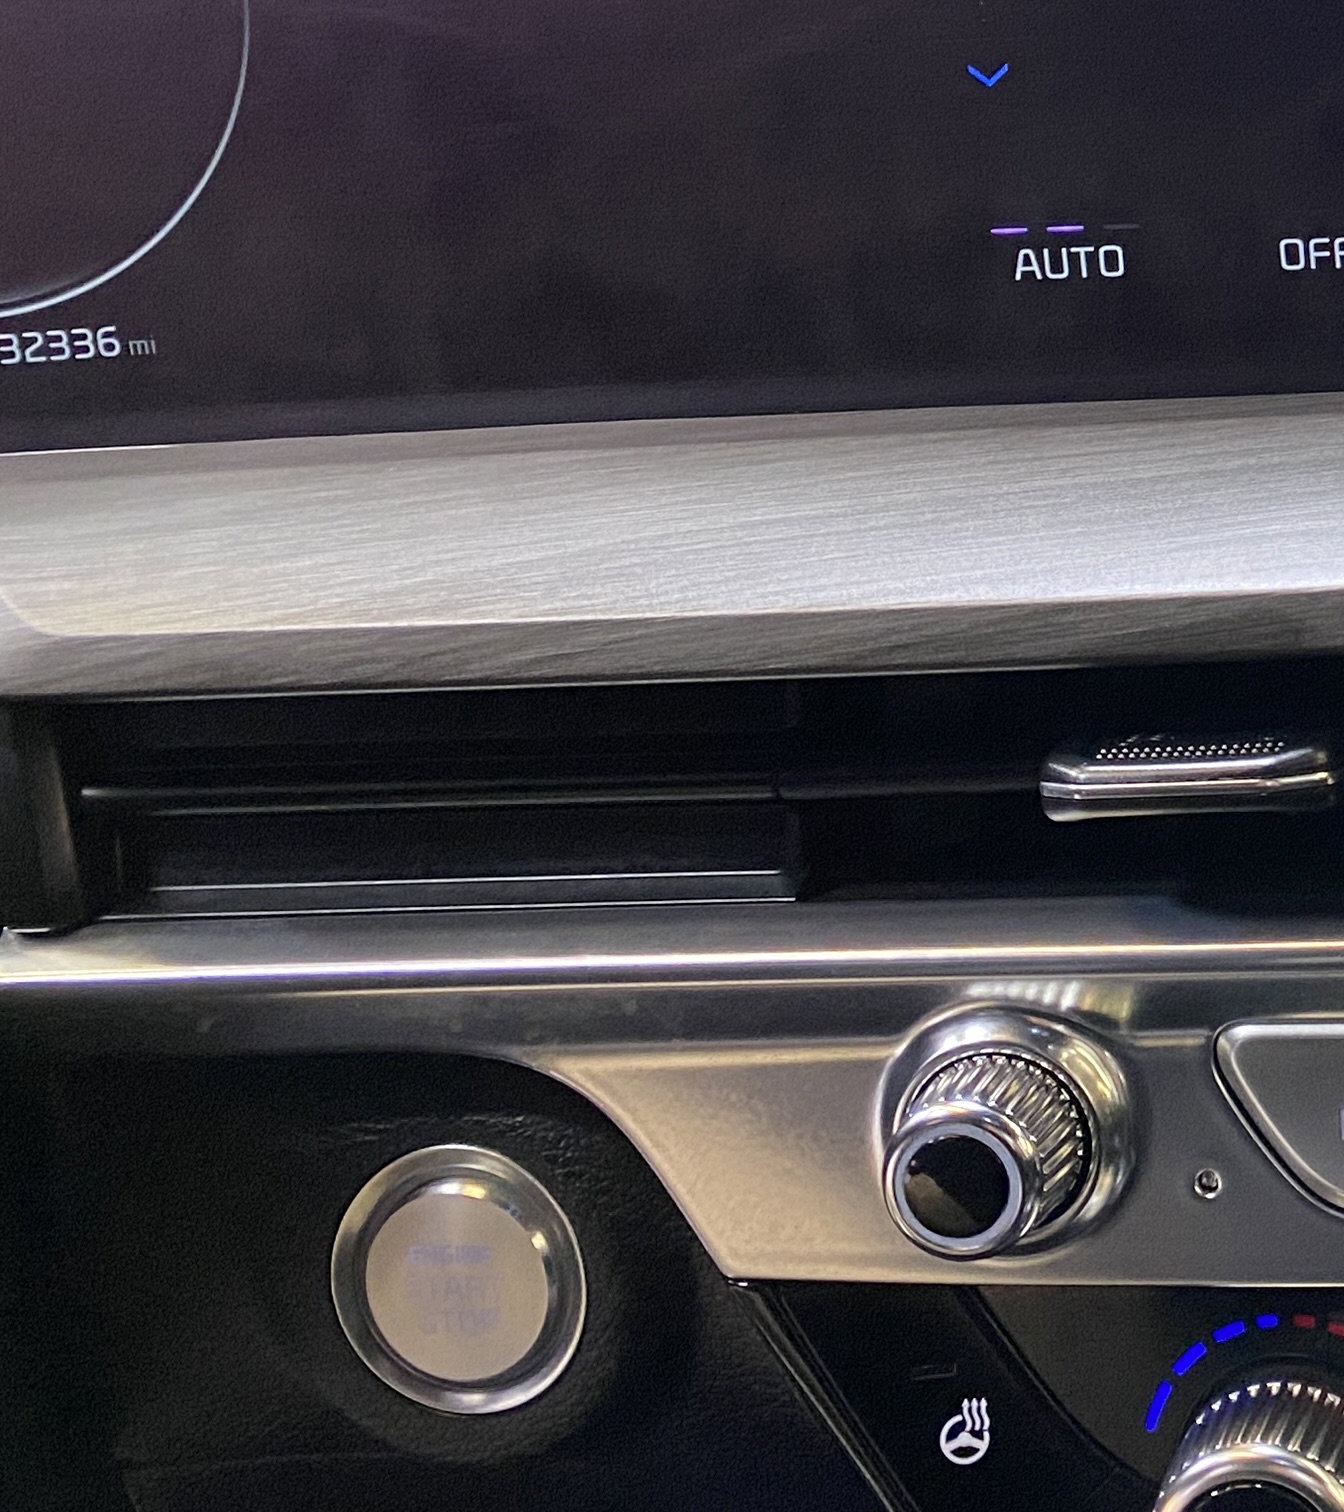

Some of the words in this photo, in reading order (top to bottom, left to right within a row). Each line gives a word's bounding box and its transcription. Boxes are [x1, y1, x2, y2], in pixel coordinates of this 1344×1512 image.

[1015, 245, 1124, 280] AUTO
[0, 326, 121, 364] 32336
[128, 336, 157, 356] mi
